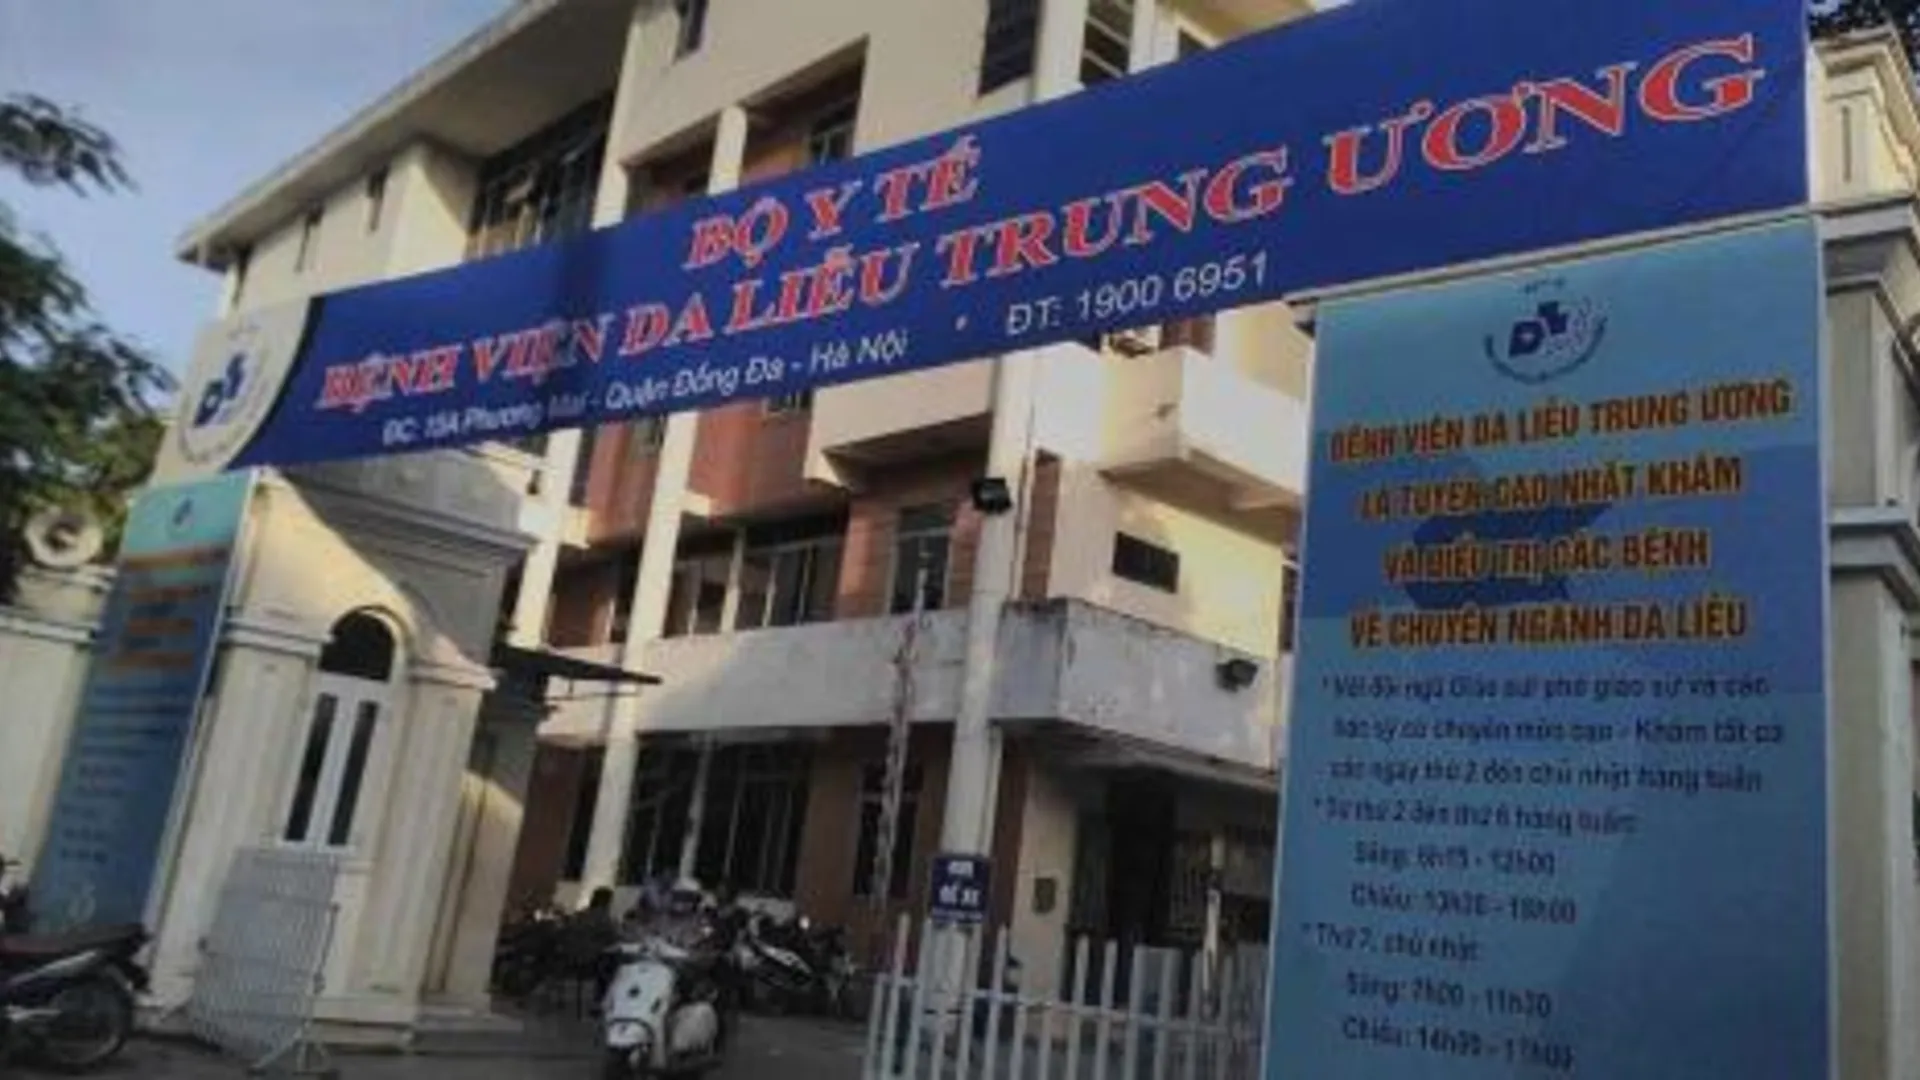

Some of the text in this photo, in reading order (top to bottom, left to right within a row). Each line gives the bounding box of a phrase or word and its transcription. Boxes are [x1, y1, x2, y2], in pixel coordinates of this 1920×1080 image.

[314, 345, 464, 413] BỆNH
[473, 312, 609, 385] VIỆN
[619, 295, 715, 357] DA
[726, 242, 920, 333] LIỄU
[937, 143, 1295, 289] TRUNG
[1323, 33, 1767, 194] ƯƠNG
[682, 134, 982, 269] BỘ Y TẾ
[1076, 273, 1165, 323] 1900
[1173, 250, 1271, 306] 6951
[1589, 390, 1690, 433] TRUNG
